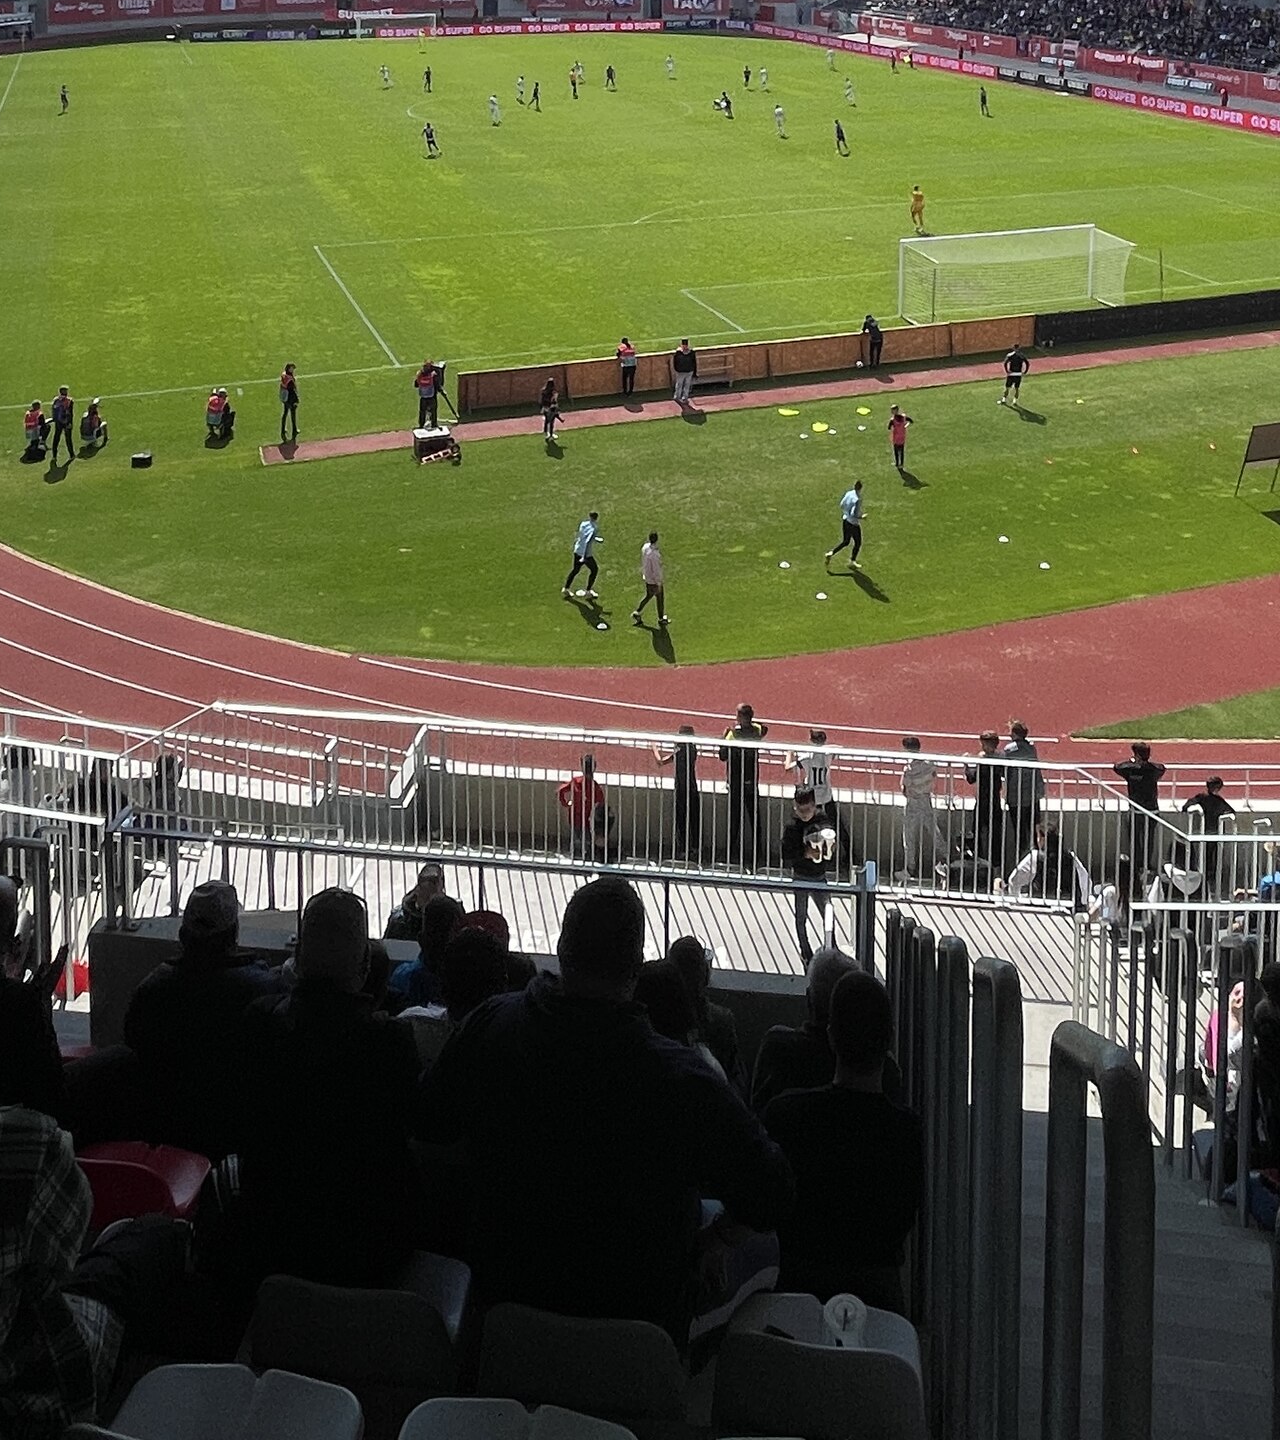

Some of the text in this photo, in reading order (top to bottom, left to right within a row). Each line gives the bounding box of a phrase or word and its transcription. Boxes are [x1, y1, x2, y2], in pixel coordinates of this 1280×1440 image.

[528, 24, 569, 32] GO SUPER
[635, 22, 661, 30] SUPER
[1095, 86, 1136, 104] GO SUPER
[1141, 96, 1187, 114] GO SUPER
[1193, 105, 1243, 125] GO SUPER
[1251, 115, 1268, 128] GO
